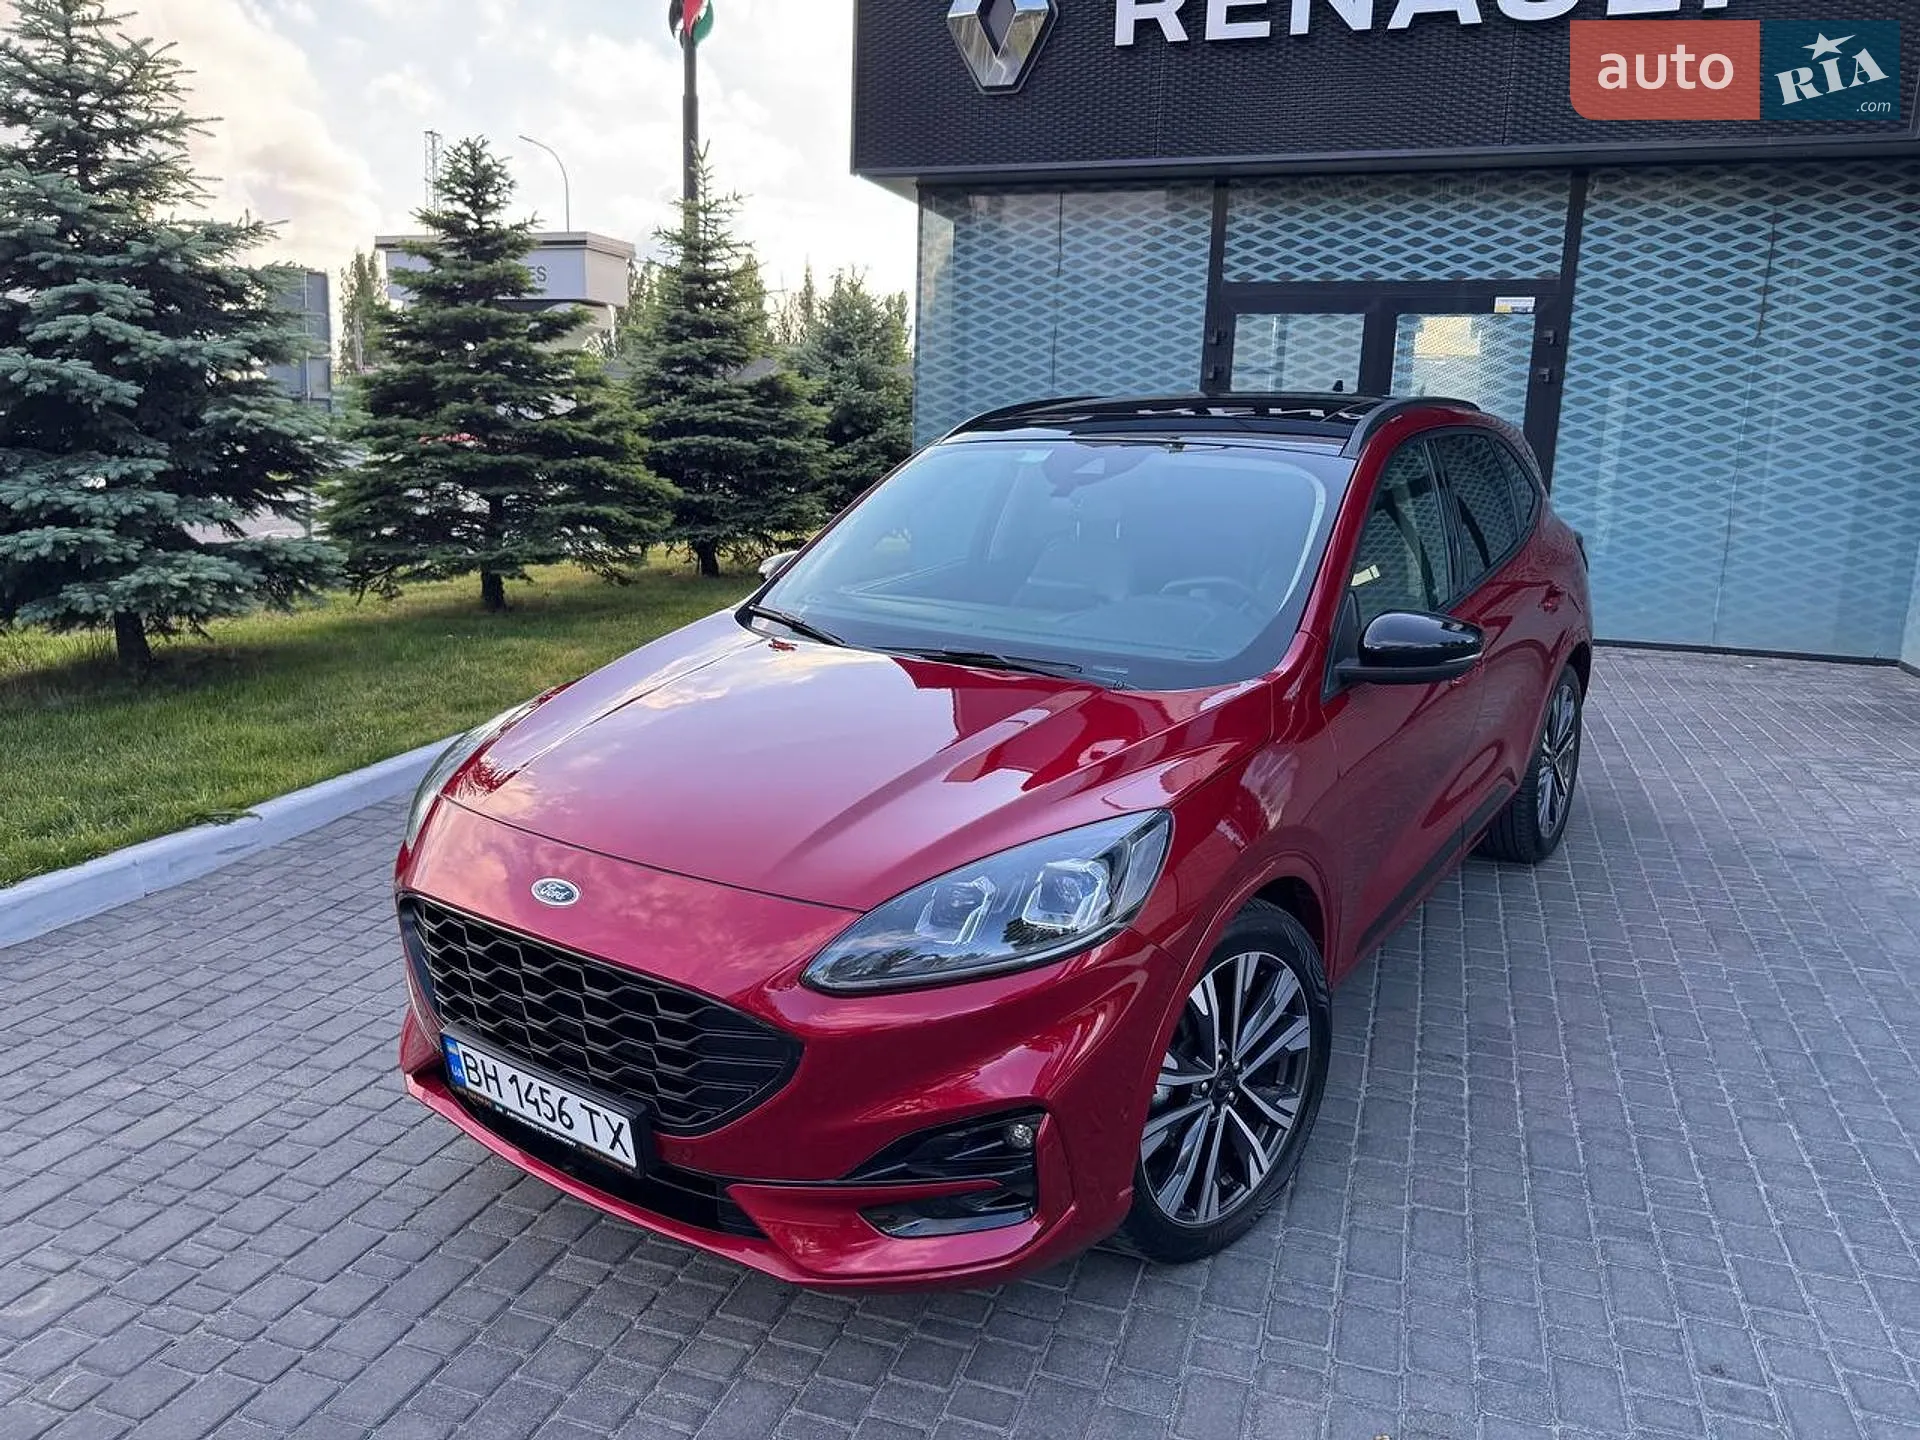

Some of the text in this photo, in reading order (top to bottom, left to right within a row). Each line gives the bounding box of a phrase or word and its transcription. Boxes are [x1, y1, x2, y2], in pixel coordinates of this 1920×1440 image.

[462, 1050, 503, 1098] BH
[508, 1074, 574, 1130] 1456
[579, 1102, 630, 1159] TX
